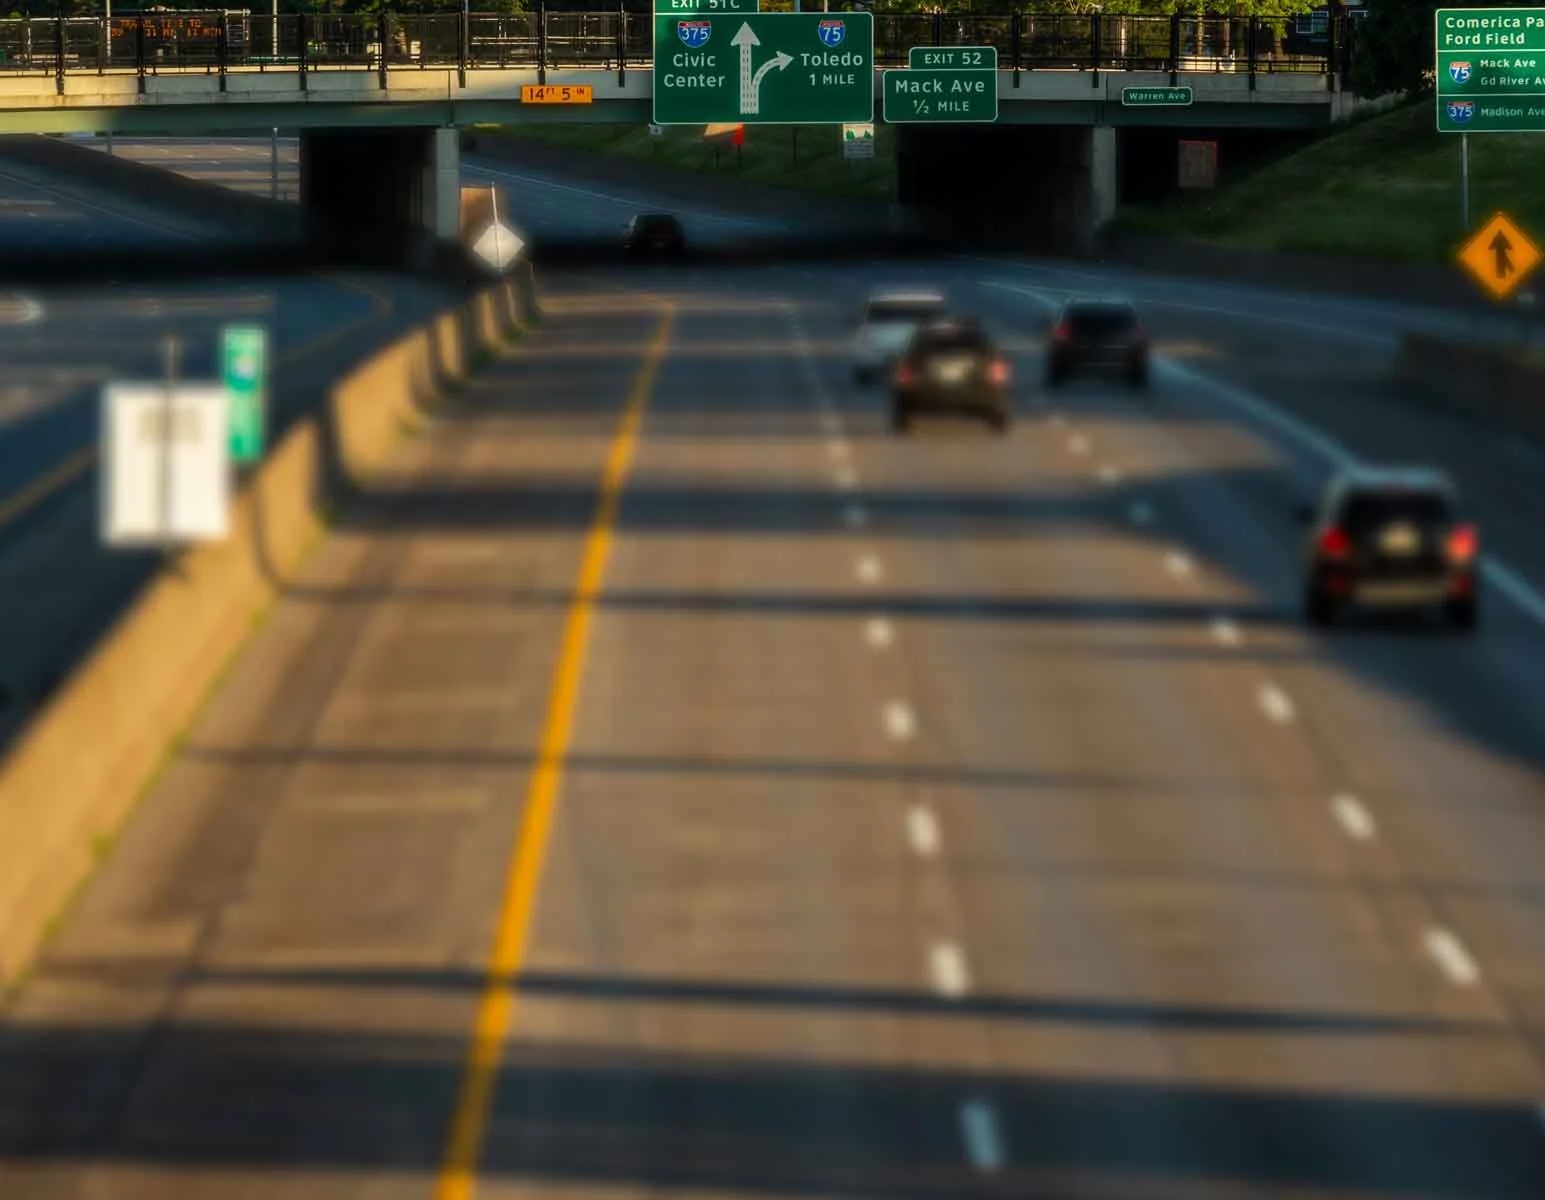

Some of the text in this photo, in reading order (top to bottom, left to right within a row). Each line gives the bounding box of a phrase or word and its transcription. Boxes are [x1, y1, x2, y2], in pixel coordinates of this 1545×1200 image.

[1445, 17, 1545, 28] Comerica Pa
[682, 28, 708, 40] 375
[823, 27, 841, 41] 75
[1445, 33, 1525, 45] Ford Field
[673, 53, 716, 67] Civic
[800, 53, 863, 67] Toledo
[924, 52, 983, 65] EXIT 52
[1480, 59, 1511, 67] Mack
[1514, 59, 1536, 67] Ave
[1451, 67, 1470, 79] 75
[664, 74, 725, 88] Center
[810, 74, 855, 85] 1 MILE
[1481, 77, 1496, 85] Gd
[1499, 76, 1529, 85] River
[895, 79, 985, 94] Mack Ave
[530, 88, 544, 100] 14
[562, 88, 570, 100] 5
[1129, 92, 1164, 100] Warren
[938, 101, 969, 112] MILE
[1449, 108, 1472, 117] 375
[1481, 108, 1523, 116] Madison
